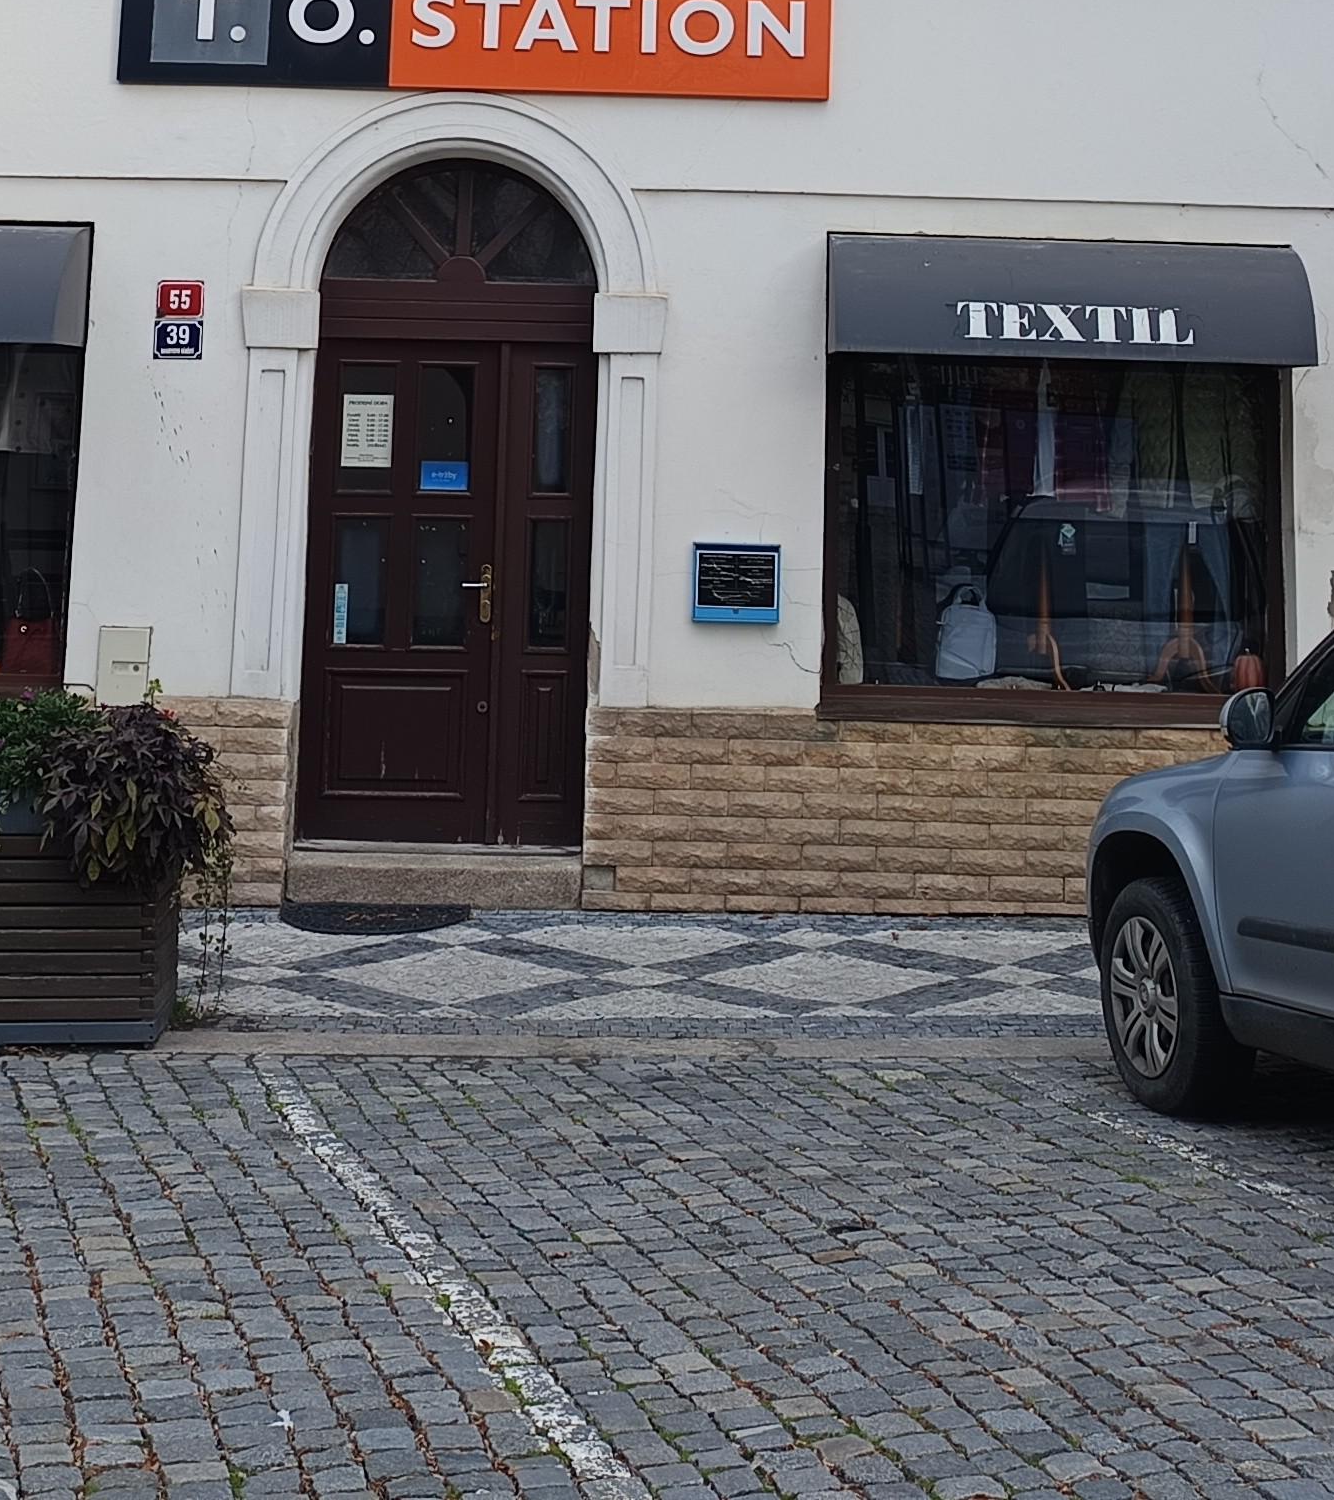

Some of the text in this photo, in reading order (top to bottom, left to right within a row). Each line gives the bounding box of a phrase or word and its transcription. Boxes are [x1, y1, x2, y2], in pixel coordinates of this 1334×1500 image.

[169, 289, 192, 310] 55
[956, 301, 1195, 346] TEXTIL
[166, 325, 190, 345] 39
